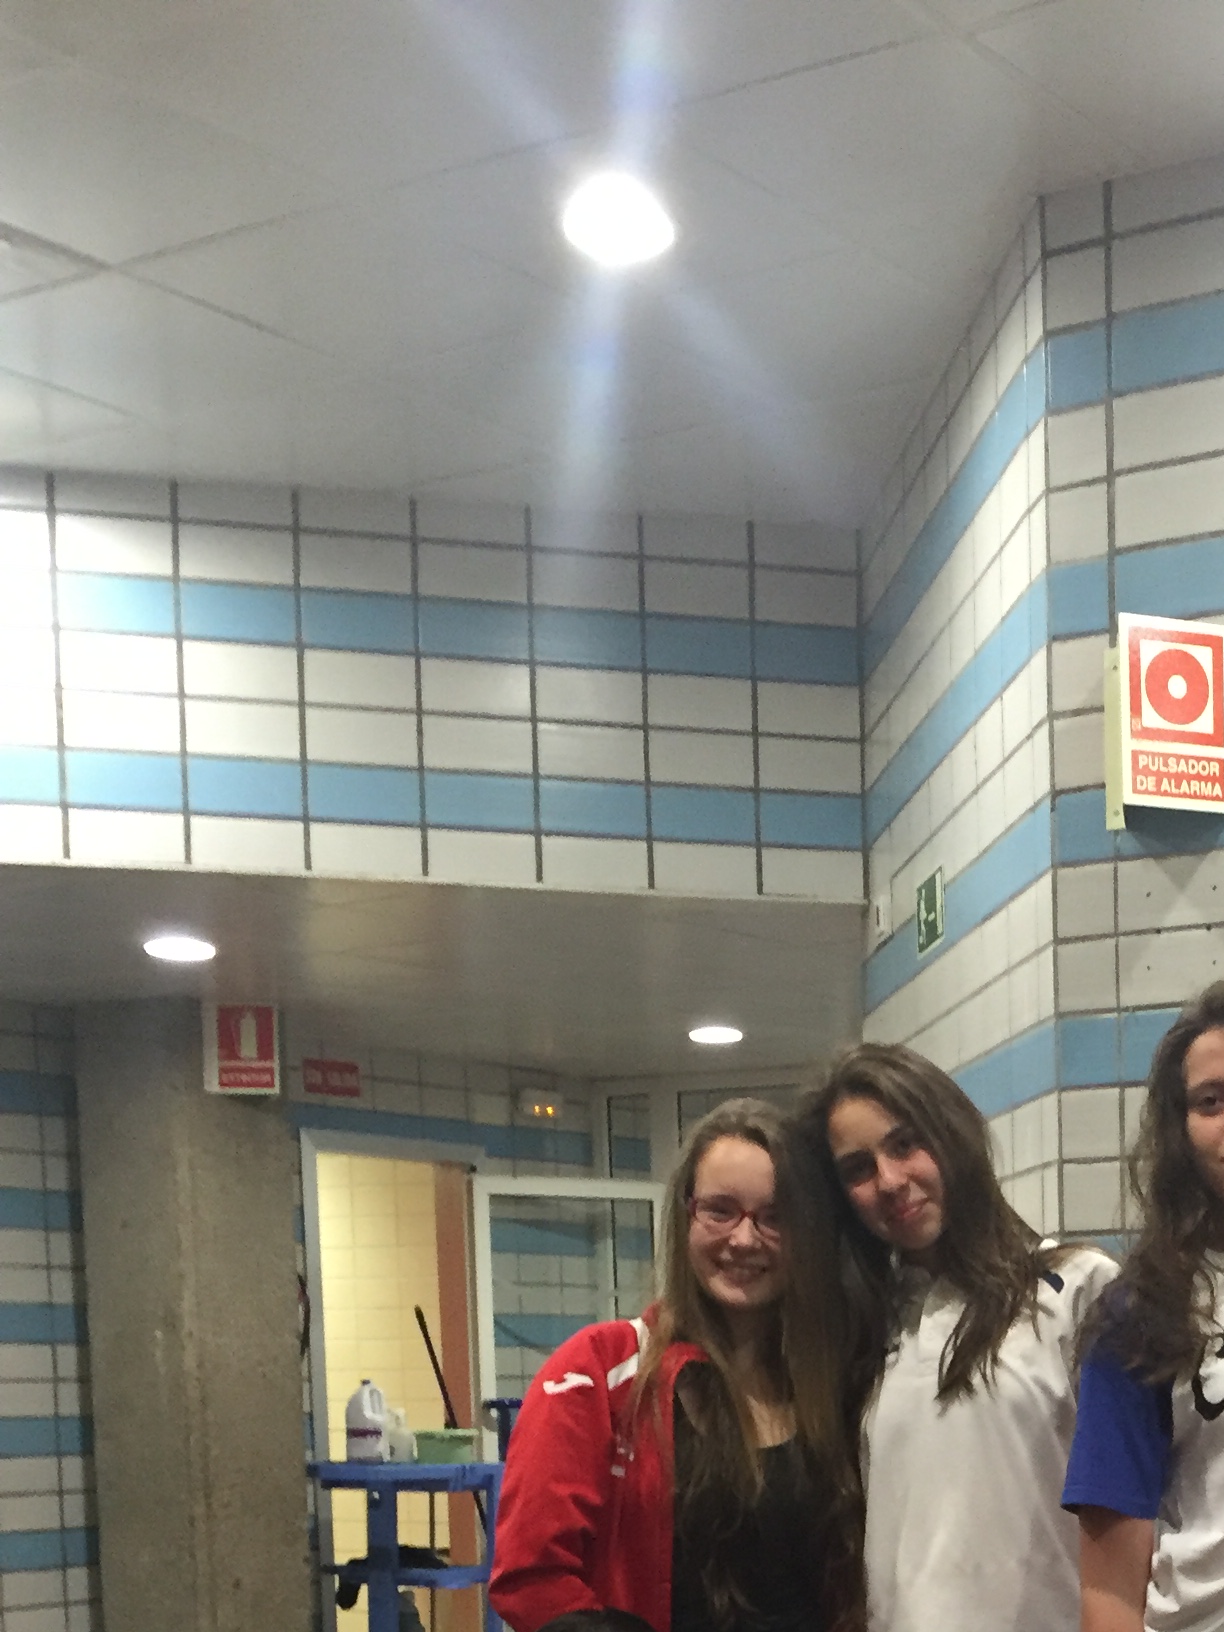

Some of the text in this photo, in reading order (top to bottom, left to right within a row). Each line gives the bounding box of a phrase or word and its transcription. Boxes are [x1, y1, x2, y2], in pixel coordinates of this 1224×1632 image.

[1138, 754, 1219, 777] PULSADOR
[1137, 775, 1222, 798] DE ALARMA
